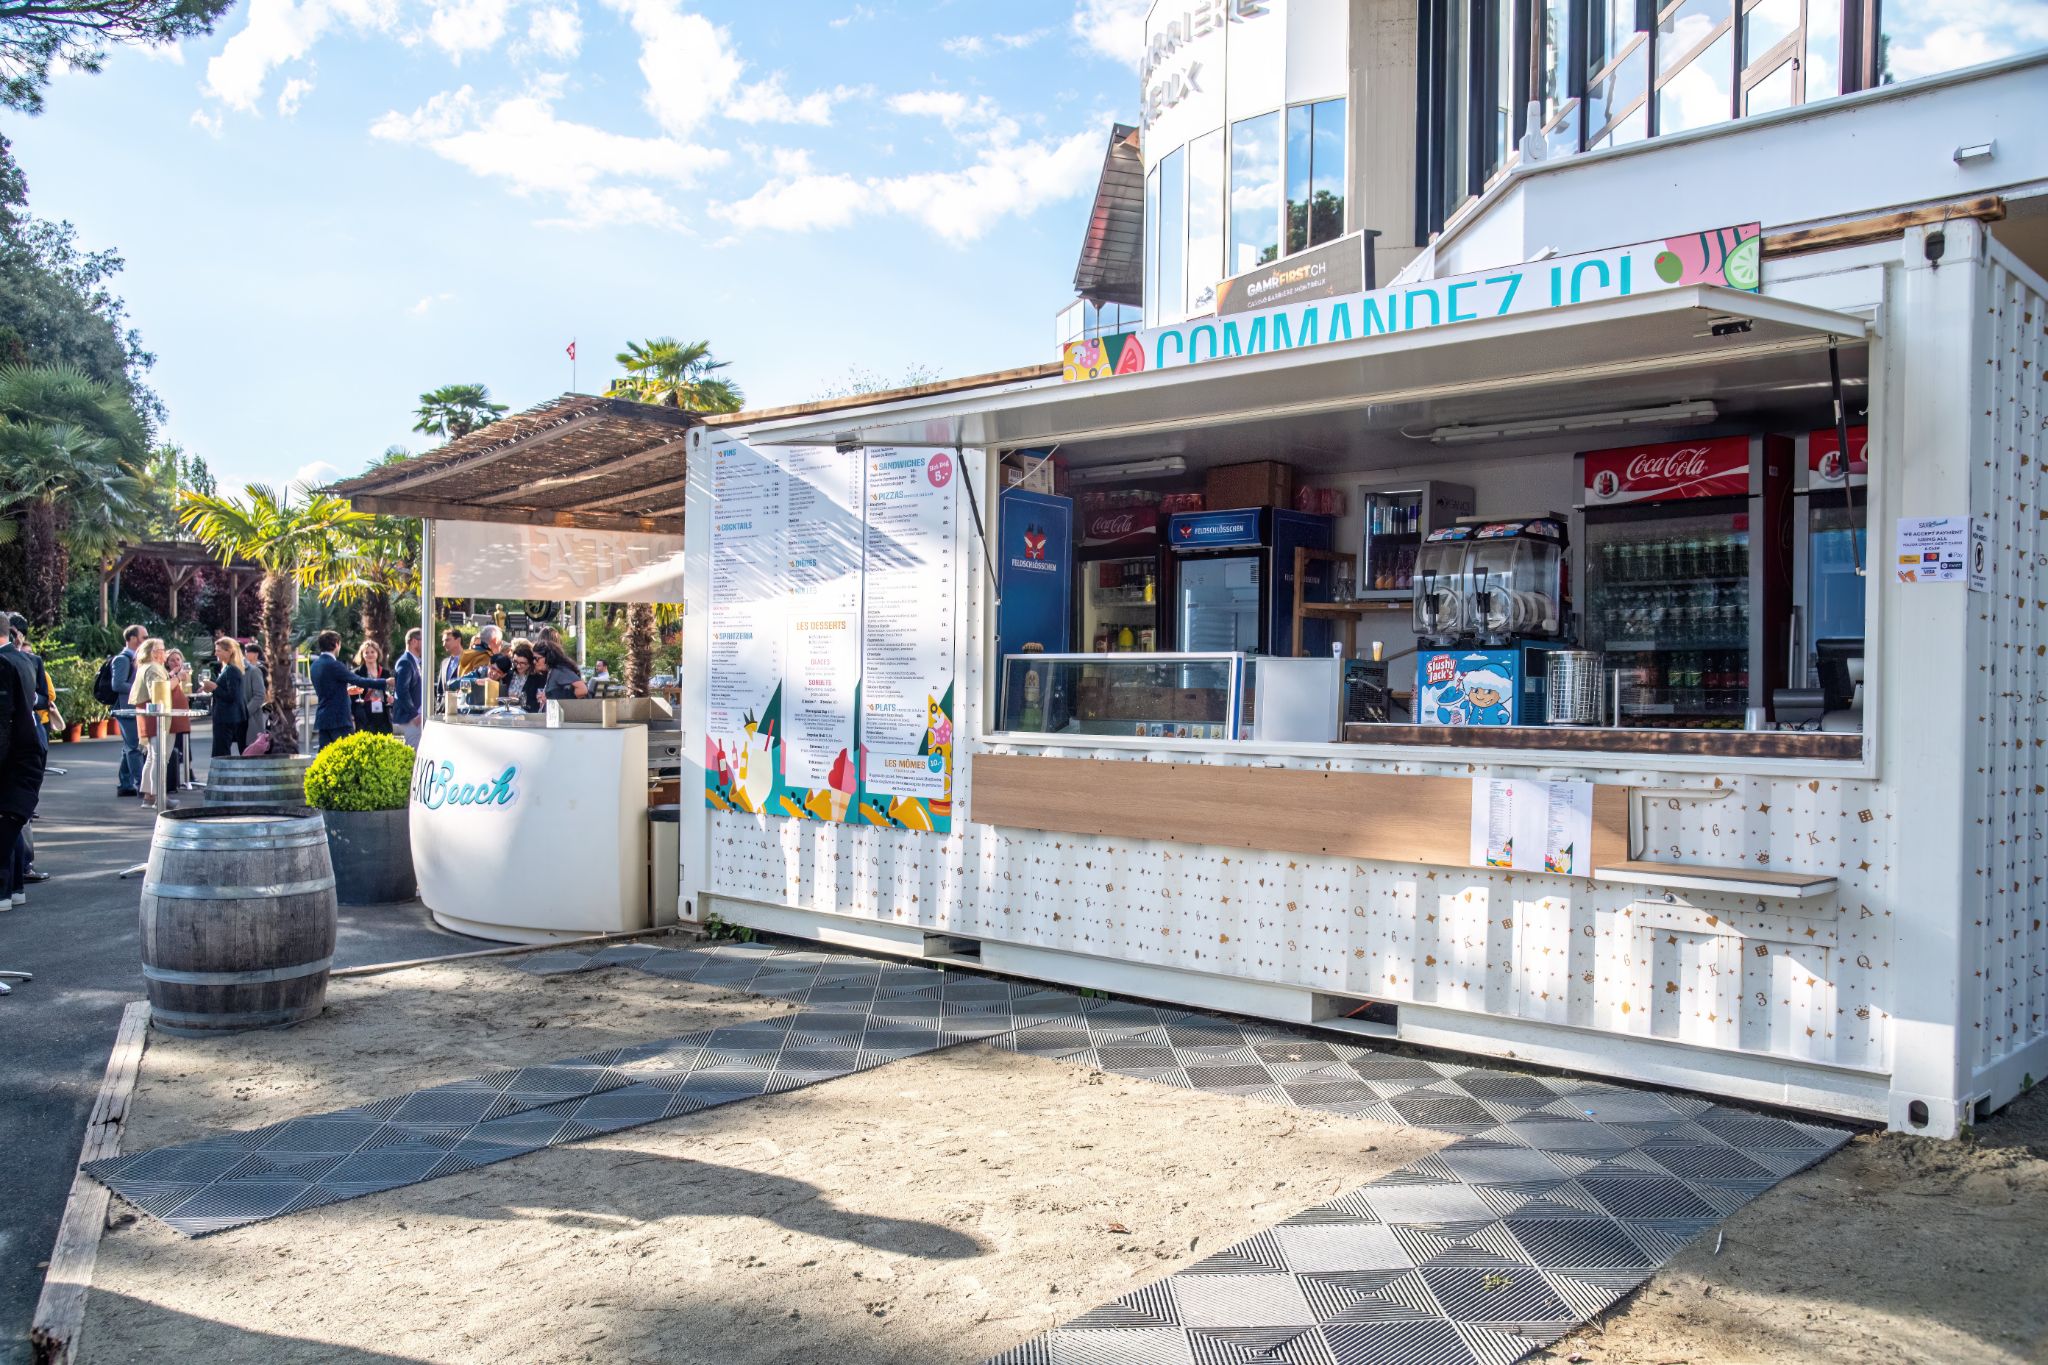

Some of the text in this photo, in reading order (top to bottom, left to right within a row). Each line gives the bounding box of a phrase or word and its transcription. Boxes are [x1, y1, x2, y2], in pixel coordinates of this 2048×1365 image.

[879, 457, 925, 471] SANDWICHES
[1626, 447, 1712, 481] Coca-Cola
[878, 490, 904, 501] PIZZAS
[721, 521, 753, 531] COCKTAILS
[1195, 524, 1244, 535] FELDSCHLÖSSCHEN
[797, 620, 847, 631] LES DESSERTS
[1427, 659, 1456, 673] Slushy
[1430, 669, 1454, 682] Jack's
[875, 703, 896, 712] PLATS
[884, 758, 926, 769] LES MÔMES
[424, 760, 515, 810] Beach
